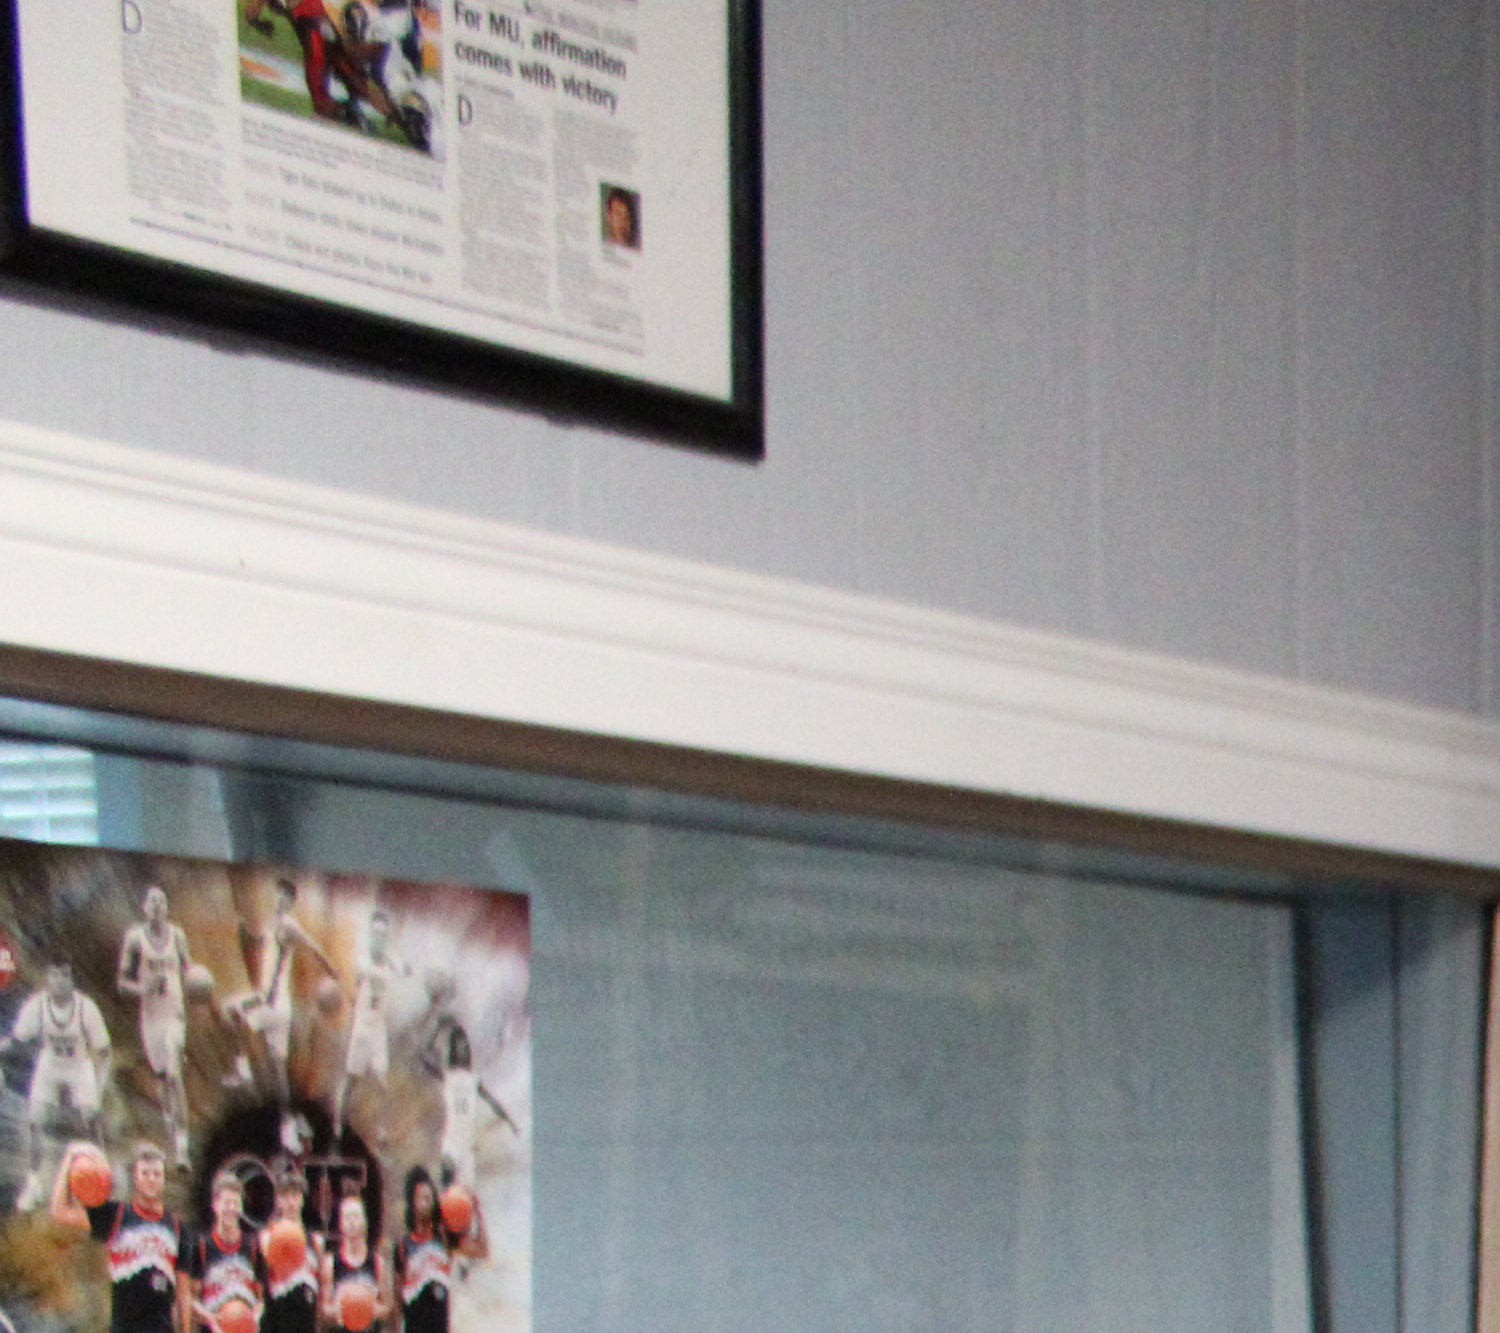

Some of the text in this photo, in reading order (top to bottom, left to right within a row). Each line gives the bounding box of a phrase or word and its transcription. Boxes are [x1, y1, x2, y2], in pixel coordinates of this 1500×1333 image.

[454, 0, 481, 31] For
[488, 11, 525, 49] MU,
[531, 29, 627, 80] affirmation
[454, 40, 513, 76] comes
[519, 60, 557, 90] with
[561, 74, 618, 116] victory
